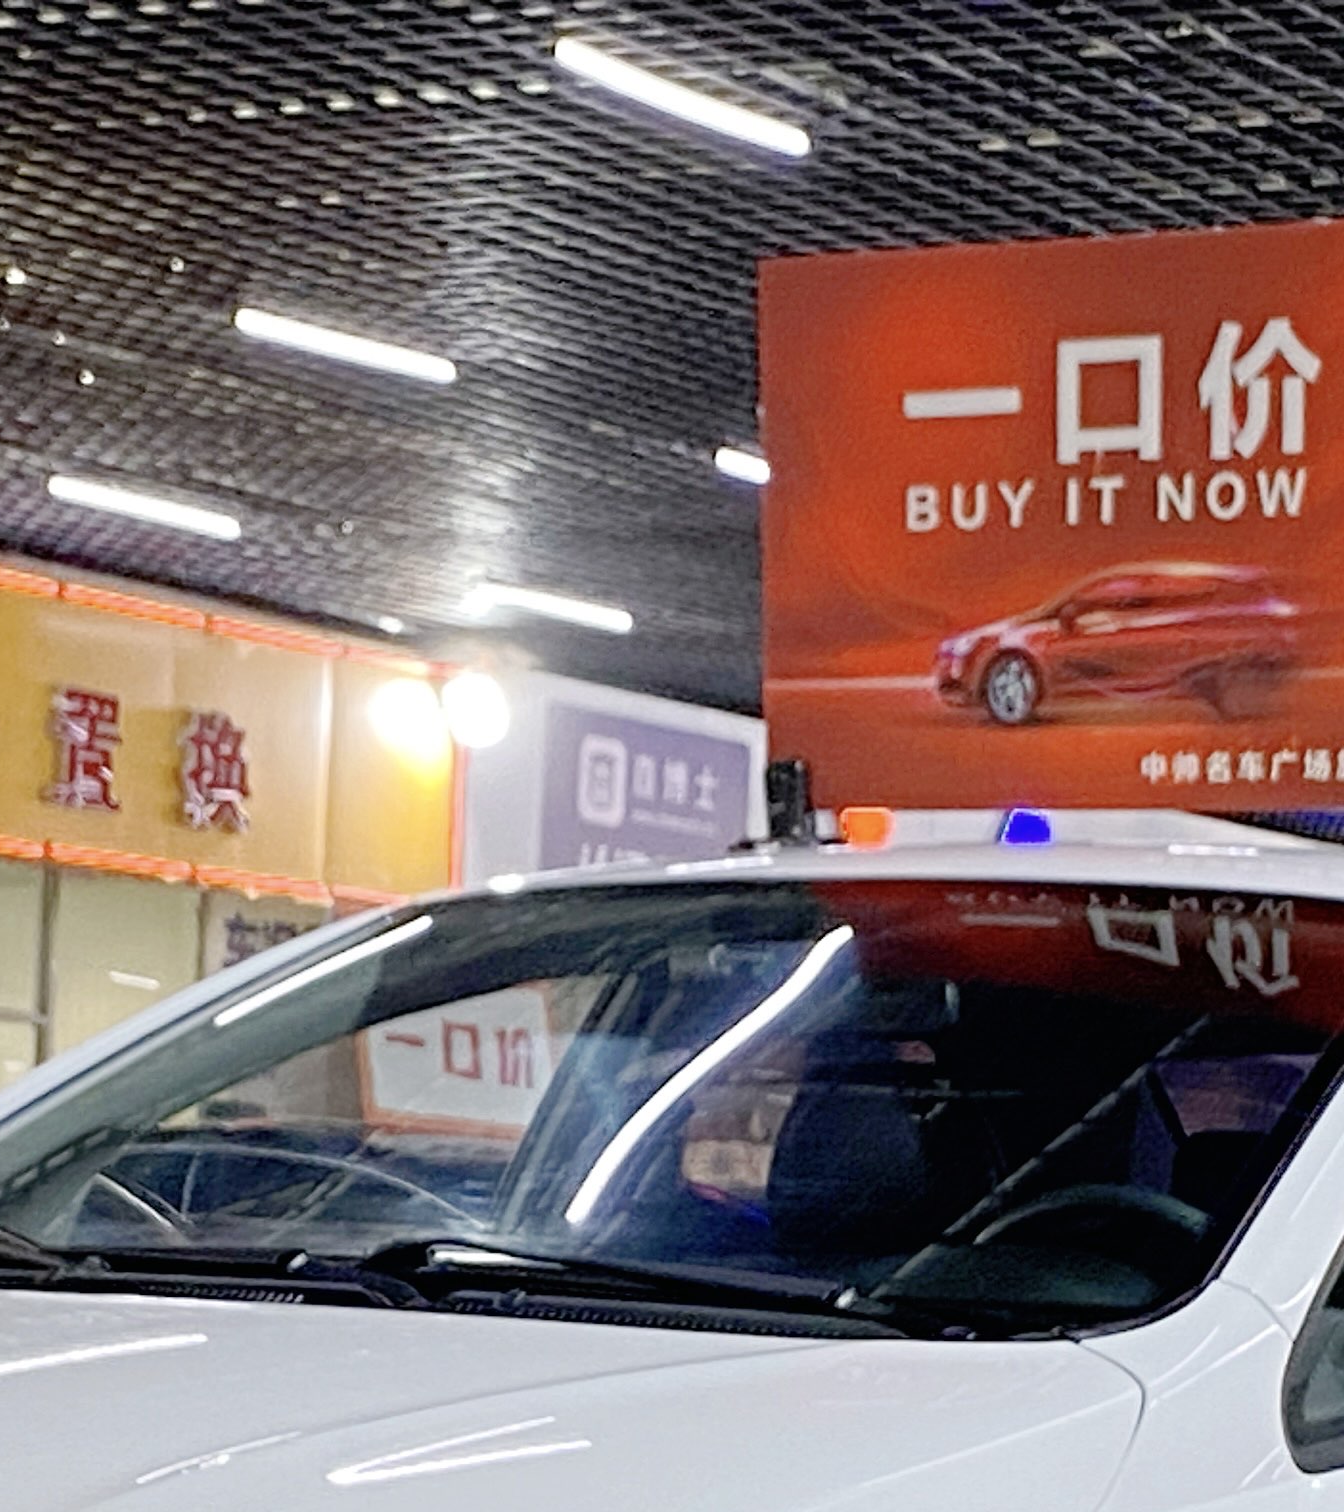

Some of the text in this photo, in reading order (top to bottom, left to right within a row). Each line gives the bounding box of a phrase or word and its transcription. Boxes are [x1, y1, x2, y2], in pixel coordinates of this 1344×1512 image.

[902, 316, 1323, 465] 一口价
[904, 468, 1309, 533] BUY IT NOW
[384, 1017, 536, 1090] 一口价
